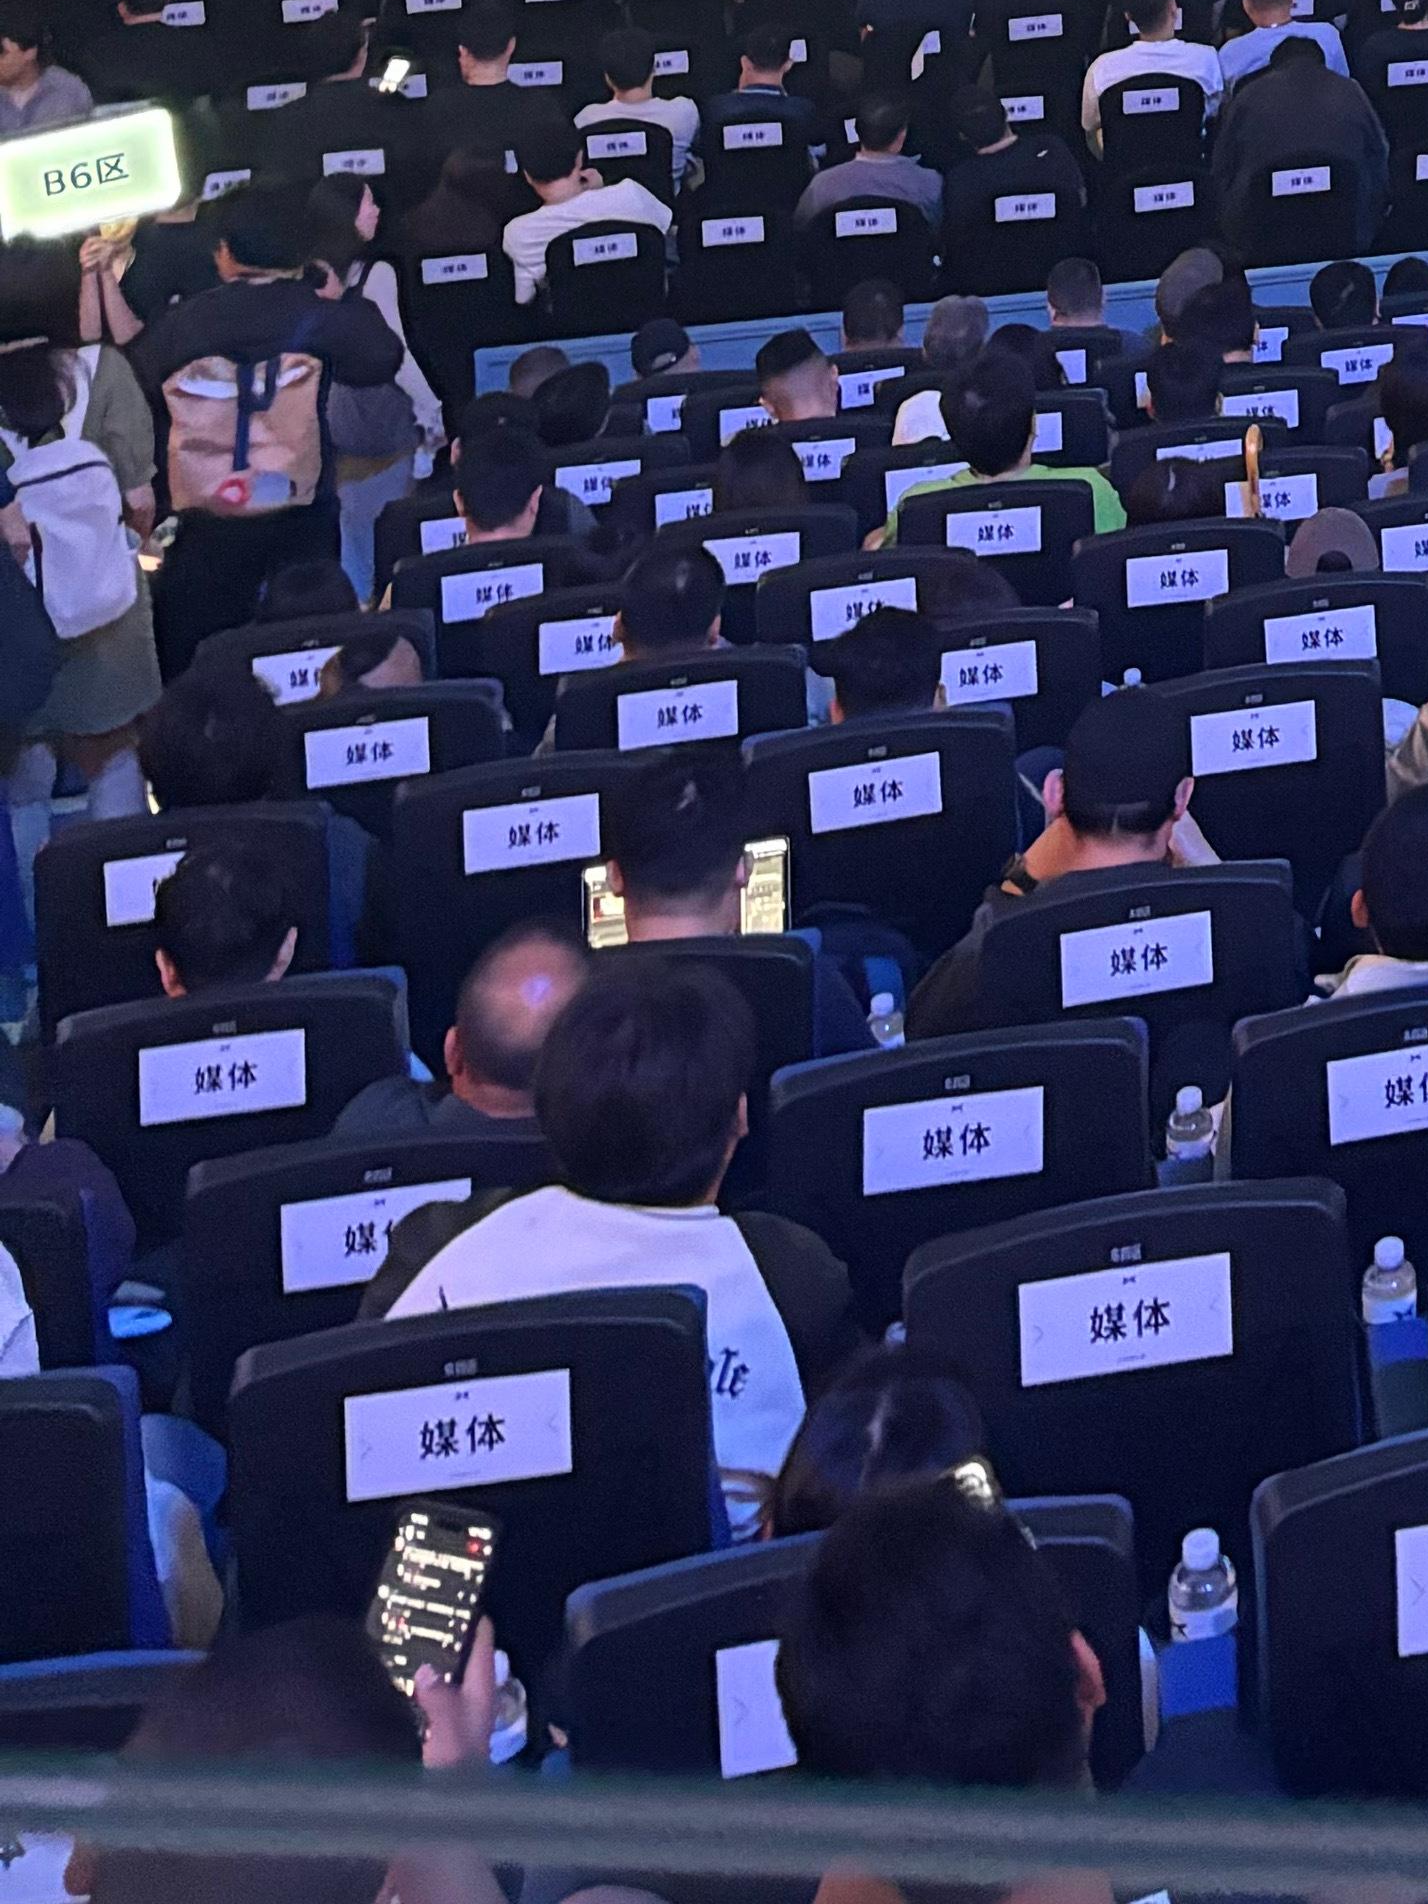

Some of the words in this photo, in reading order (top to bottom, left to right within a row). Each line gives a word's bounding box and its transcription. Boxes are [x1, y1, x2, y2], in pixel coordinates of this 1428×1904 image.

[44, 153, 129, 196] B6区
[1345, 358, 1372, 372] 媒体
[978, 524, 1014, 543] 媒体
[736, 551, 773, 570] 媒体
[1160, 569, 1198, 589] 媒体
[1302, 627, 1343, 651] 媒体
[960, 664, 1003, 687] 媒体
[658, 704, 702, 728] 媒体
[1232, 726, 1279, 752] 媒体
[347, 742, 392, 765] 媒体
[854, 780, 903, 808] 媒体
[508, 822, 559, 849] 媒体
[1111, 943, 1168, 976] 媒体
[195, 1061, 257, 1095] 媒体
[923, 1122, 991, 1160] 媒体
[1090, 1297, 1170, 1344] 媒体
[420, 1414, 505, 1460] 媒体
